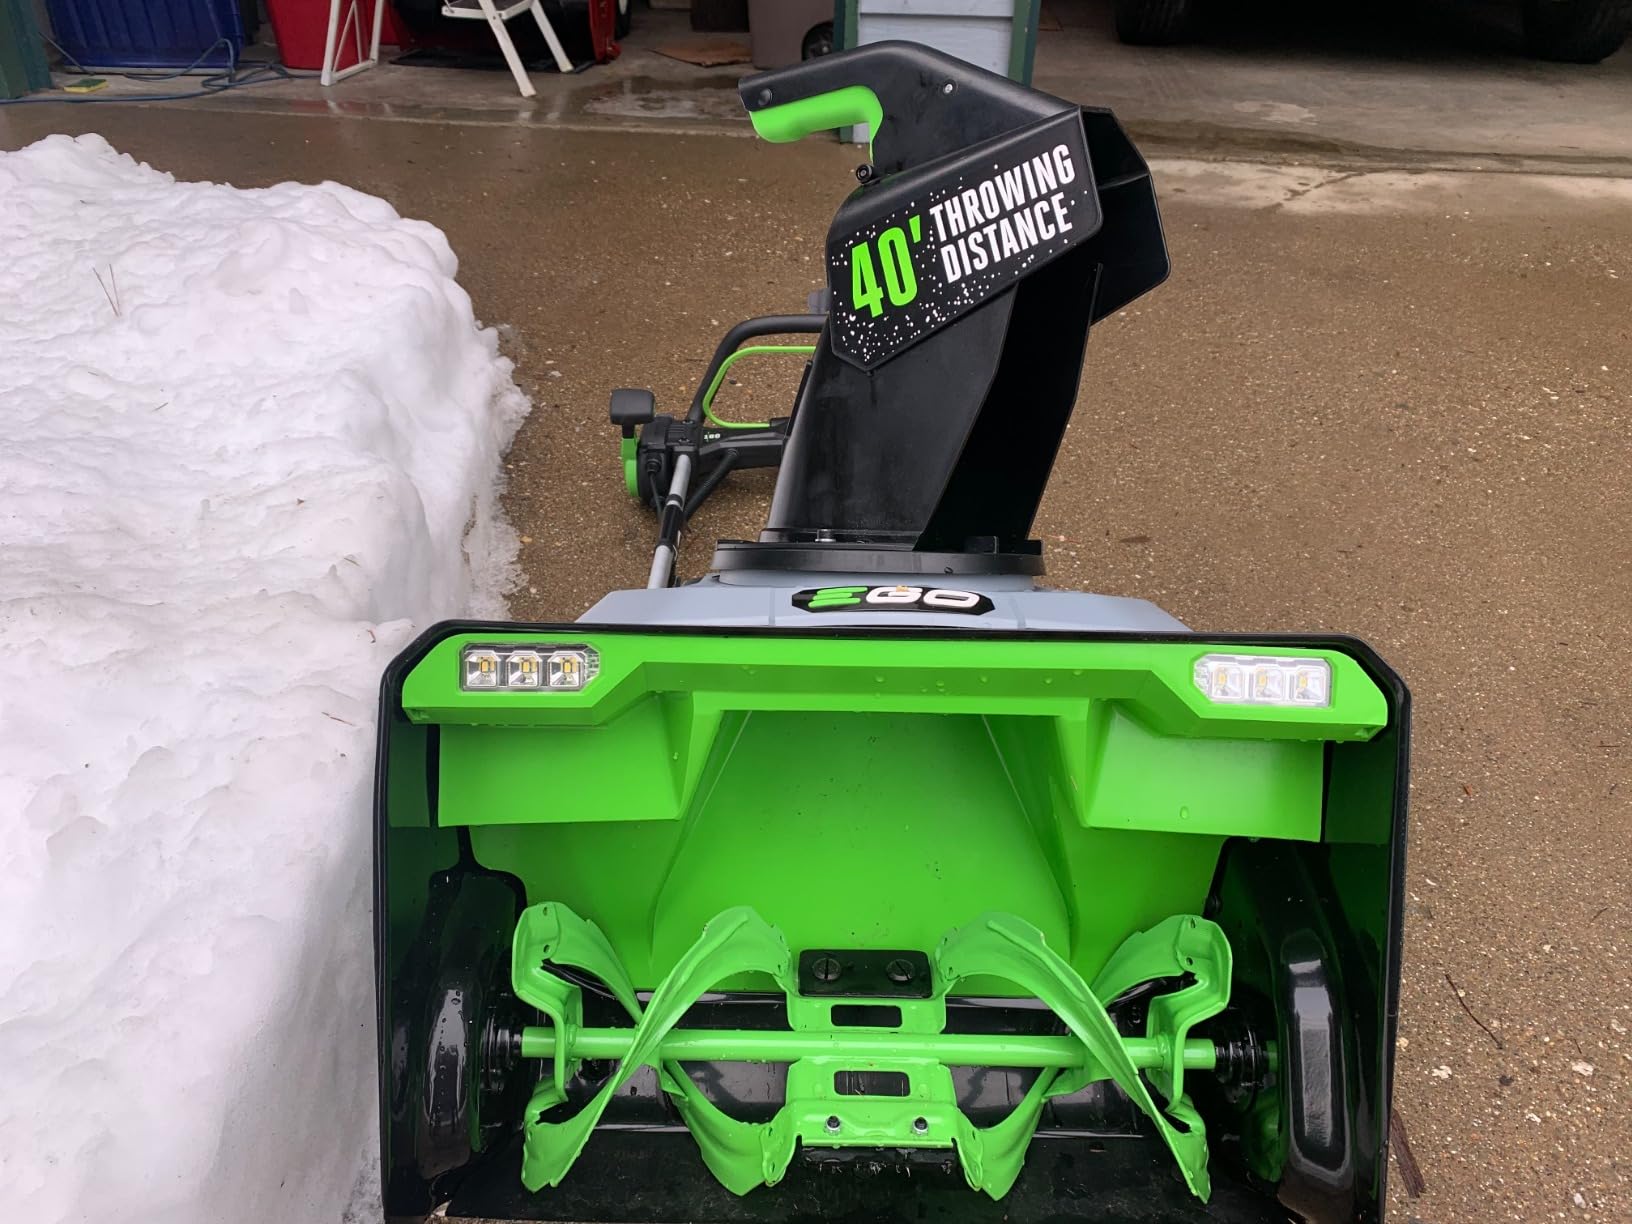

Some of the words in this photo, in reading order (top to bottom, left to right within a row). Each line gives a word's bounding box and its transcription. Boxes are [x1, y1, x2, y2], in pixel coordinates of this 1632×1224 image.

[929, 144, 1076, 242] THROWING
[940, 192, 1073, 284] DISTANCE
[851, 215, 921, 318] 40'
[807, 586, 980, 608] EGO
